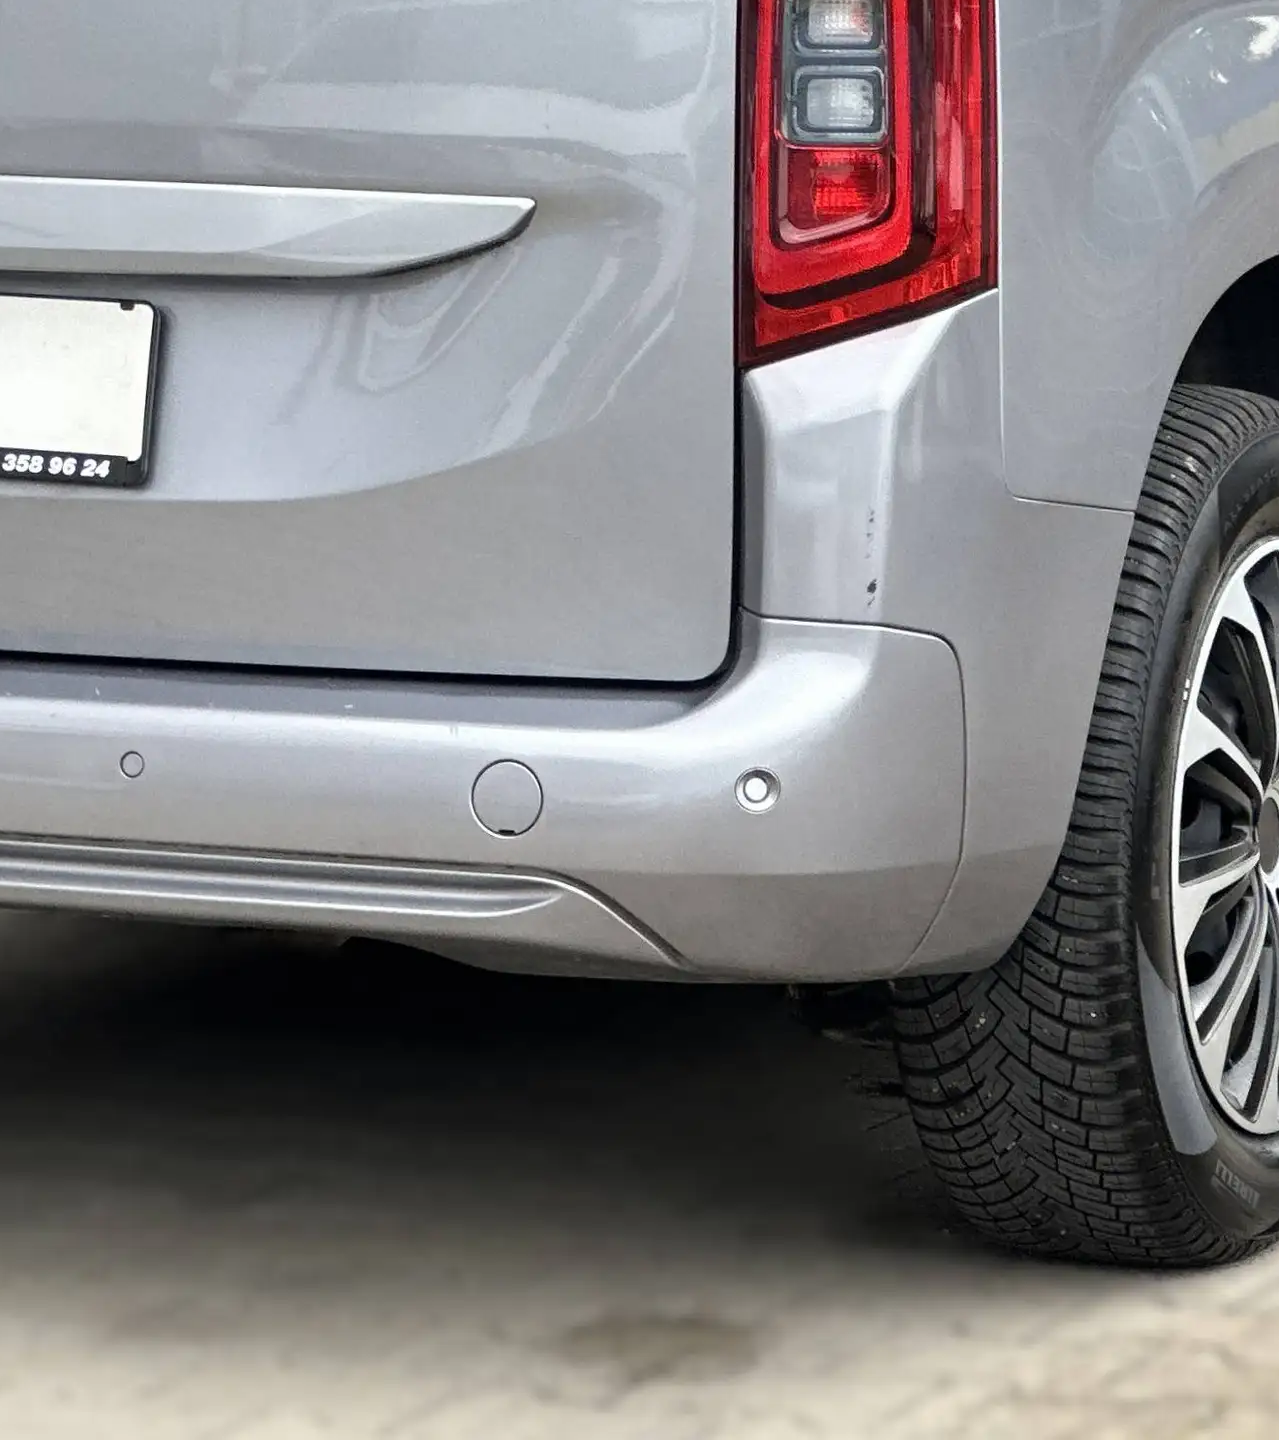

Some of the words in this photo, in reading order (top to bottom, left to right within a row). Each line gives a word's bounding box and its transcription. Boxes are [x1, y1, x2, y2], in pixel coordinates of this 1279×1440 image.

[1, 452, 43, 474] 358
[48, 456, 77, 476] 96
[80, 458, 111, 478] 24
